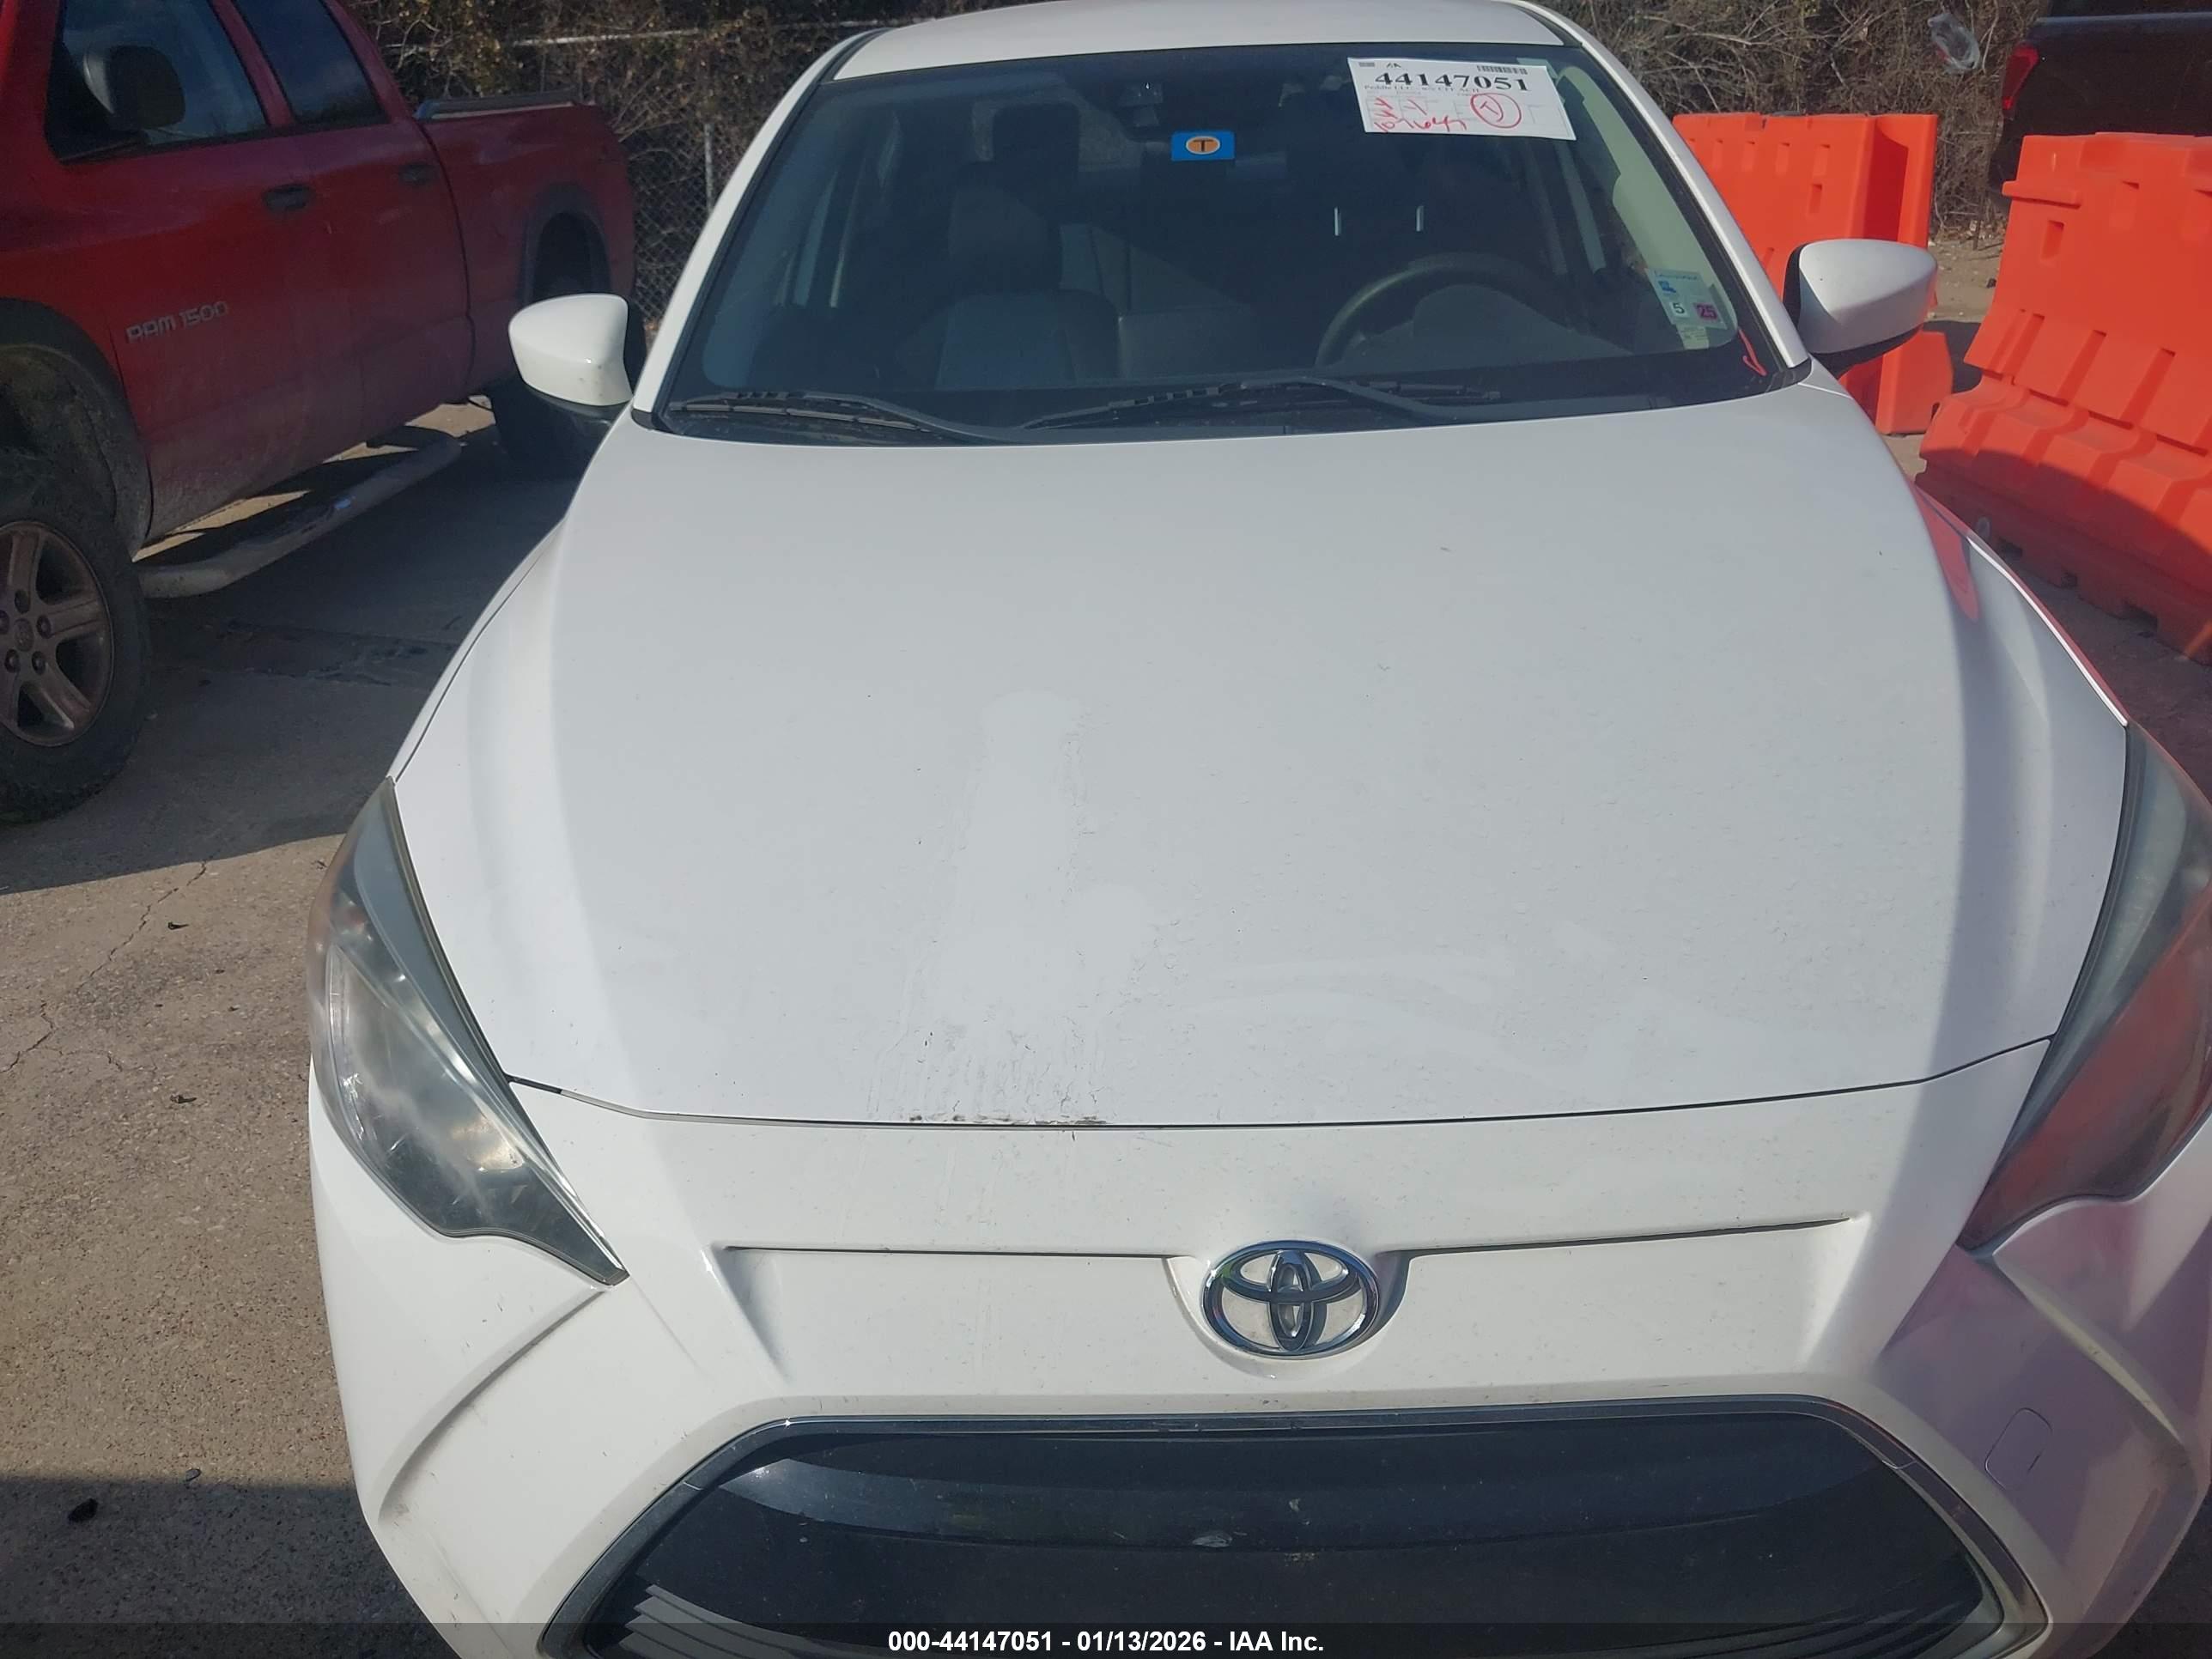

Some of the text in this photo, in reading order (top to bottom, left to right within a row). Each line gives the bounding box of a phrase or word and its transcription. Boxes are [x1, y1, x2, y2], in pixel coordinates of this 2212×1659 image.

[1375, 72, 1529, 91] 44147051
[1194, 139, 1213, 152] T
[1672, 302, 1718, 319] 5 25
[126, 301, 228, 343] RAM 1500
